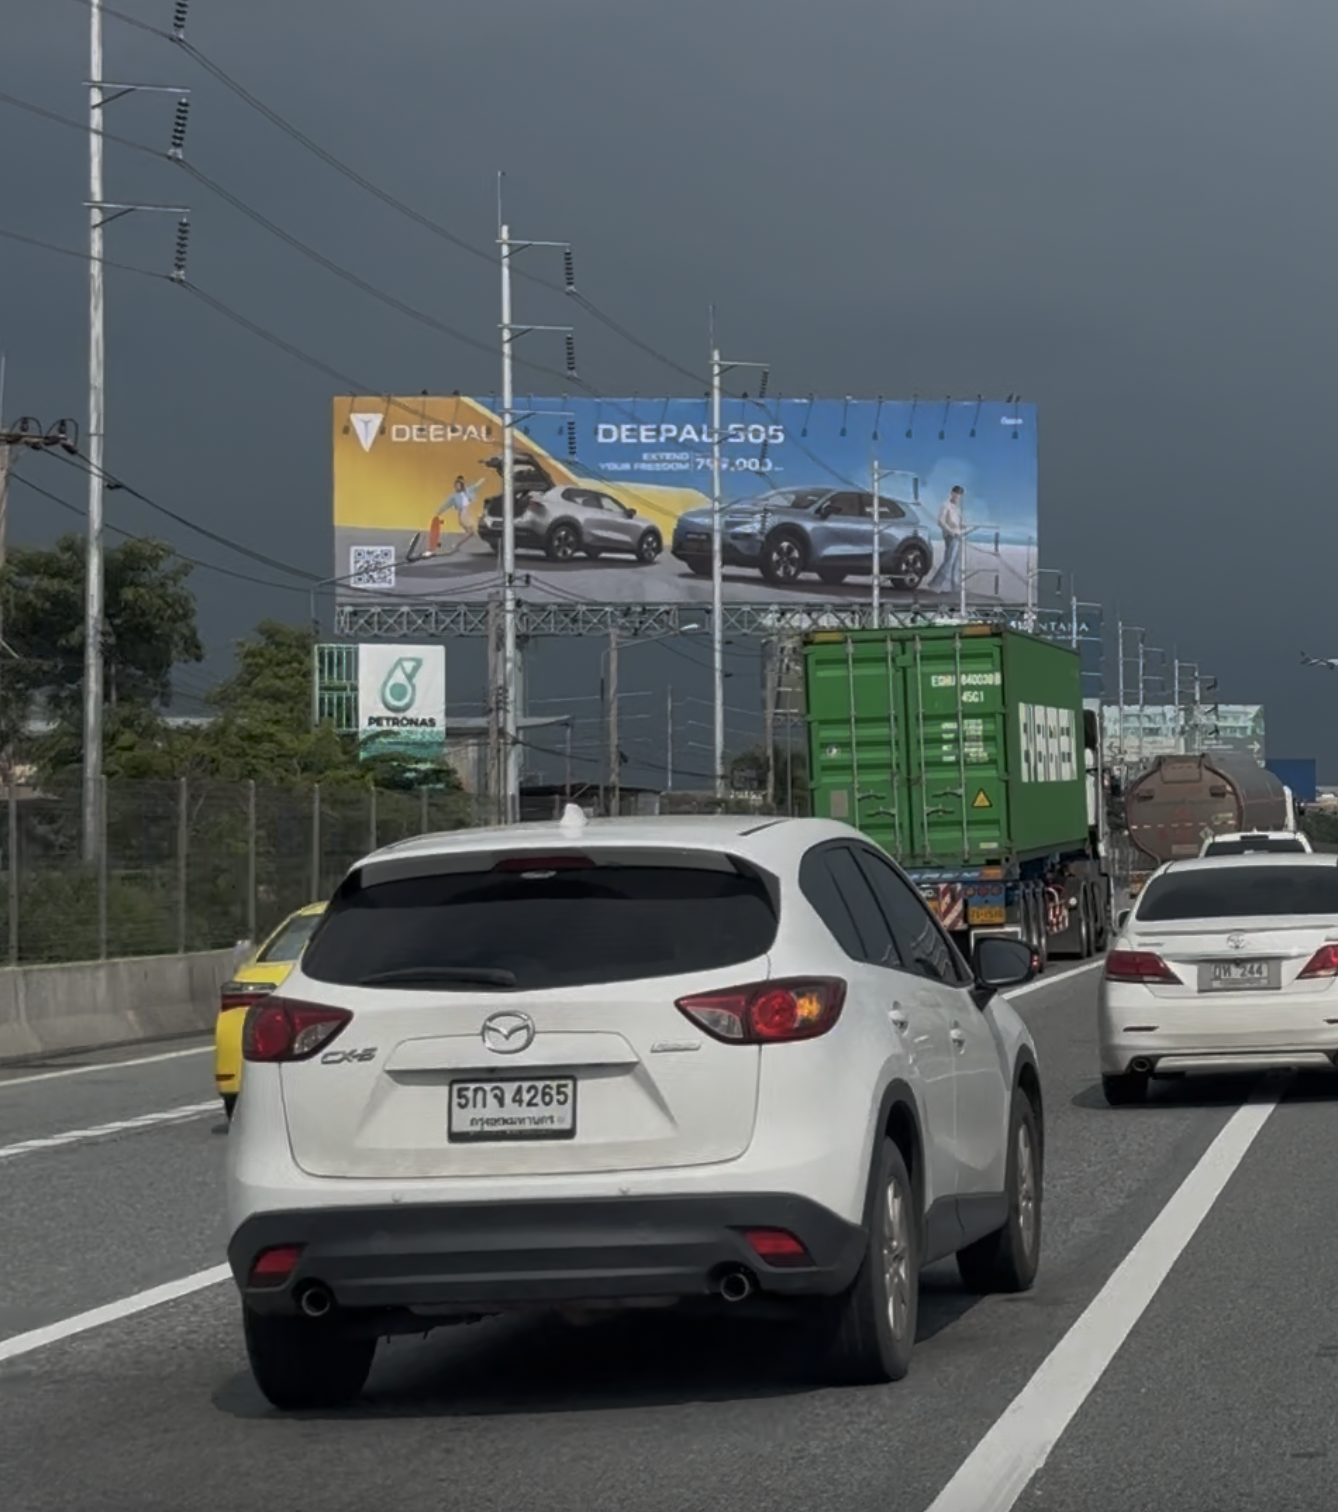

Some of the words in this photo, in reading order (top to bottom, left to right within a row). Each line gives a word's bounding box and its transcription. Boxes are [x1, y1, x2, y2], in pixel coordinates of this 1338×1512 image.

[391, 424, 495, 442] DEEPAL
[597, 423, 715, 443] DEEPAL
[367, 716, 437, 727] PETRONAS
[1239, 963, 1264, 977] 244
[456, 1085, 505, 1110] 5กจ
[511, 1083, 570, 1108] 4265
